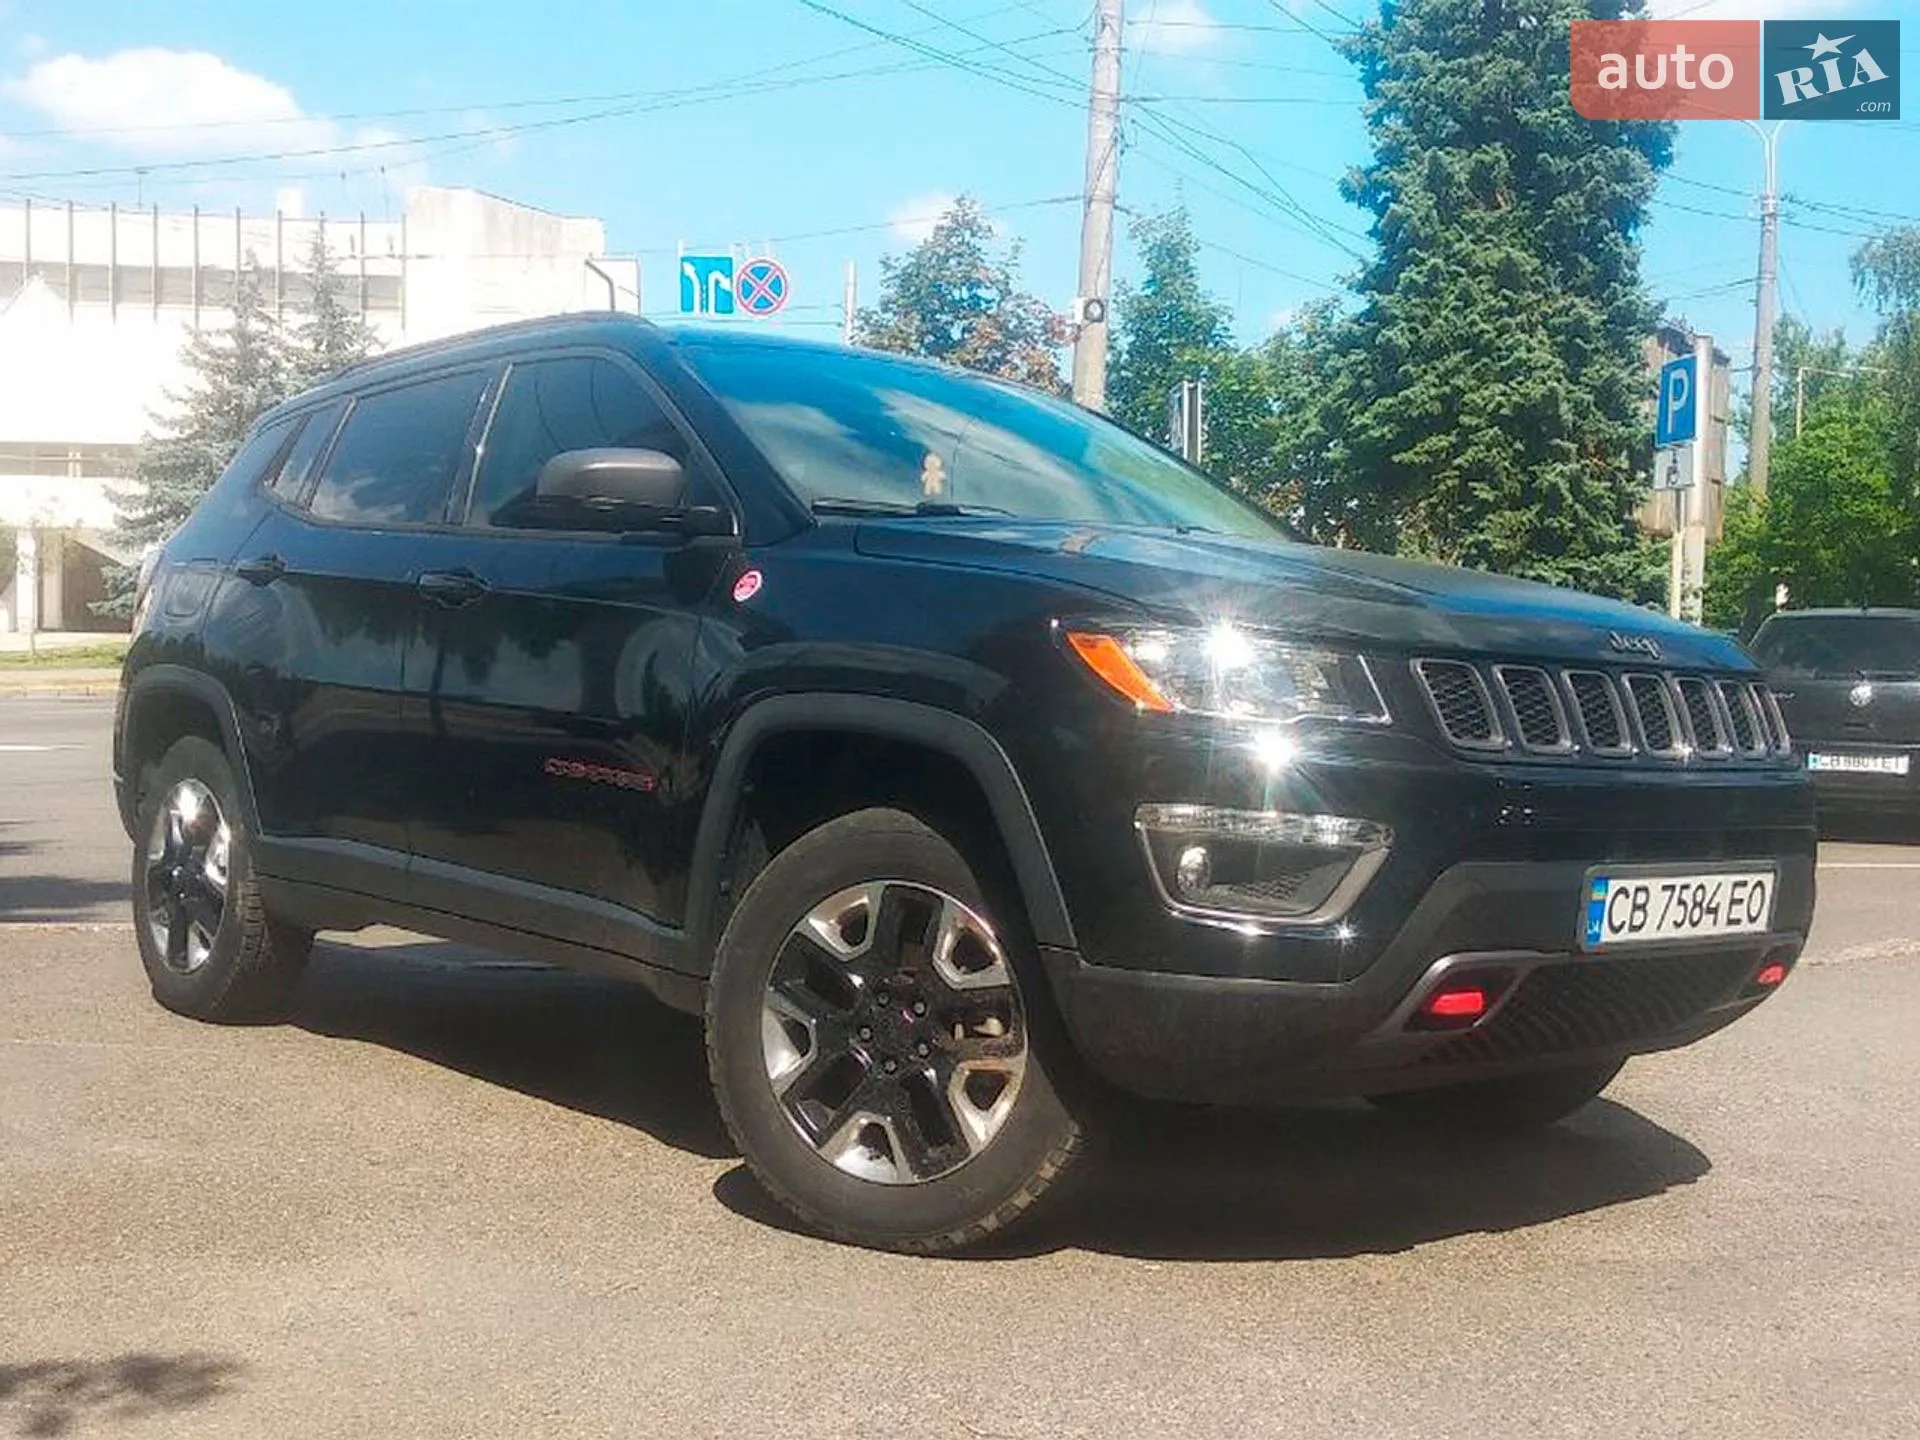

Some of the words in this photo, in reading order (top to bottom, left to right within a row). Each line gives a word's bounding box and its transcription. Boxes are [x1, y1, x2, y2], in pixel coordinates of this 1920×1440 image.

[1667, 368, 1689, 434] P
[1607, 886, 1650, 935] CB
[1656, 881, 1723, 931] 7584
[1726, 879, 1766, 926] EO
